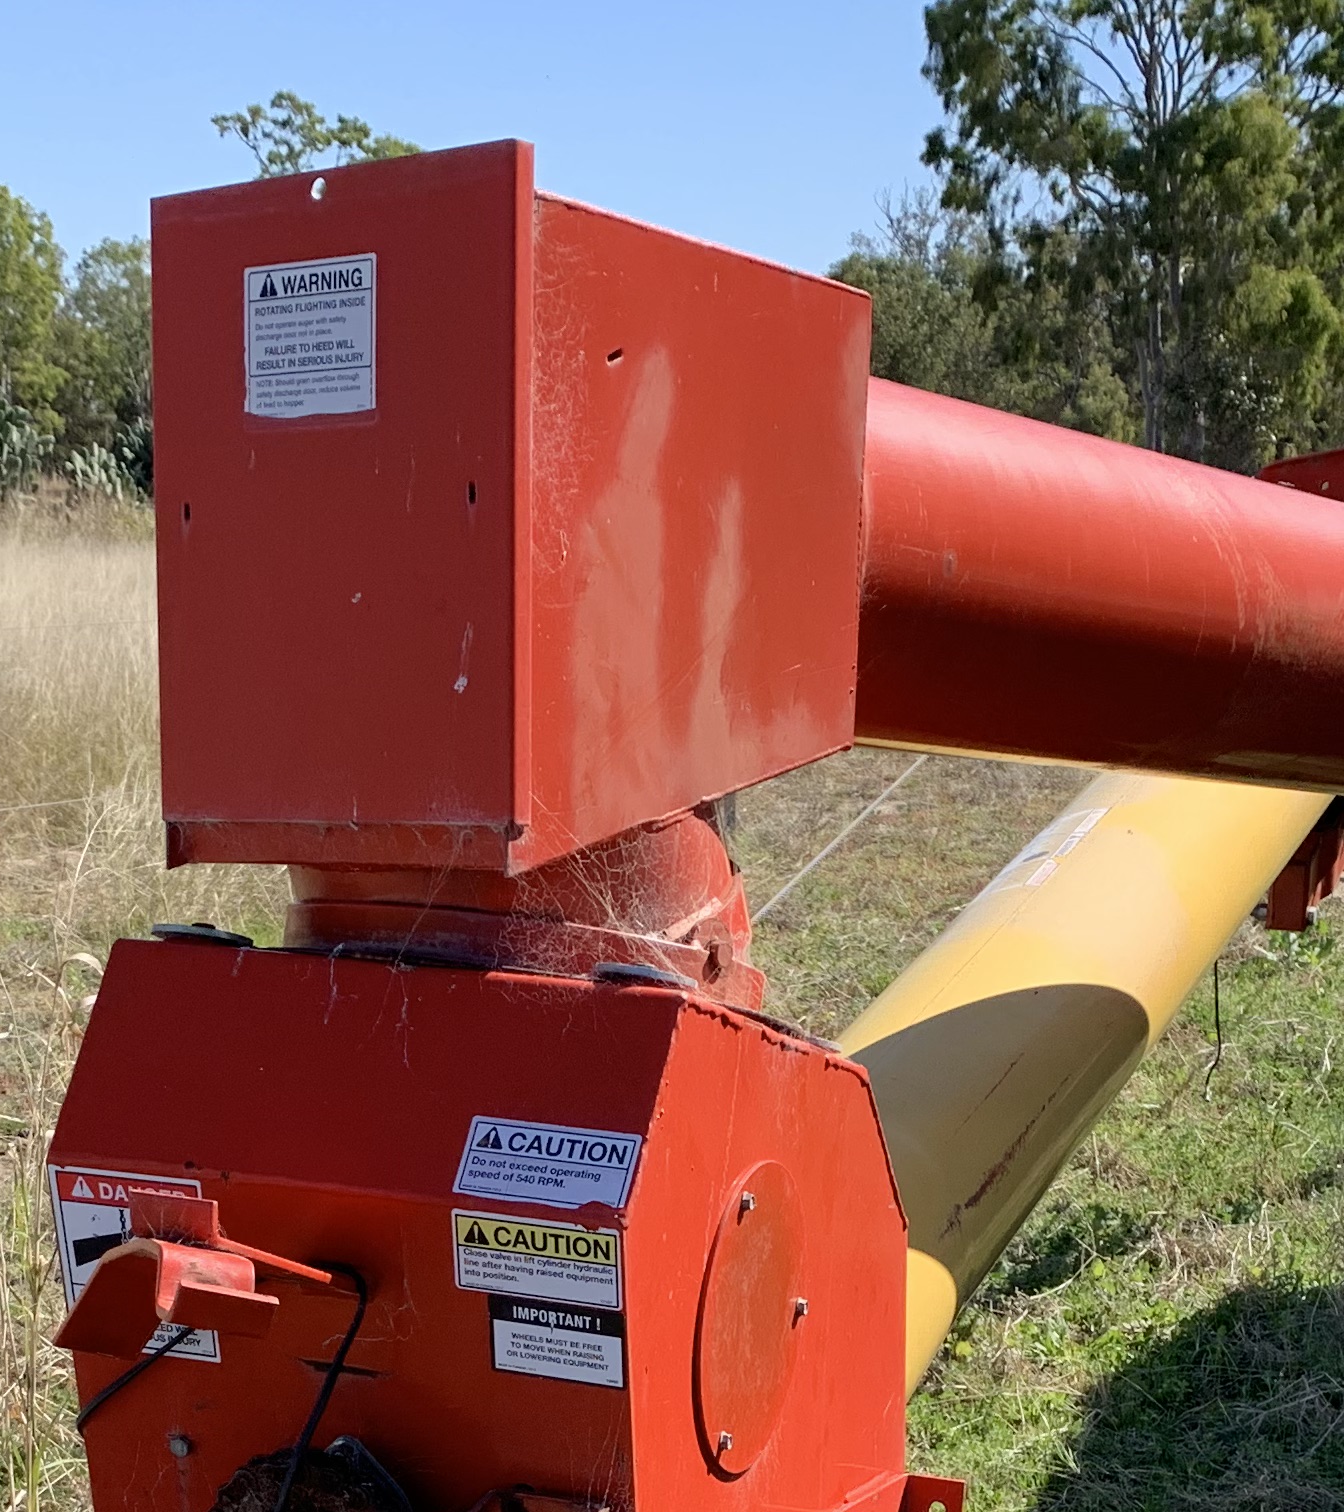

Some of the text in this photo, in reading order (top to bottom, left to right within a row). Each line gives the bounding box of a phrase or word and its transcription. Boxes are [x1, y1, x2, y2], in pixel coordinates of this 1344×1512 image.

[282, 268, 363, 294] WARNING
[255, 296, 366, 316] ROTATING FLIGHTING INSIDE
[265, 339, 355, 355] FAILURE TO HEED WILL
[257, 352, 364, 370] RESULT IN SERIOUS INJURY
[508, 1132, 628, 1164] CAUTION
[472, 1156, 601, 1181] Do not exceed operating
[468, 1170, 565, 1188] speed of 540 RPM.
[494, 1227, 610, 1260] CAUTION
[464, 1248, 488, 1258] Close
[490, 1252, 512, 1262] valve
[524, 1256, 534, 1264] lift
[537, 1258, 571, 1269] cylinder
[574, 1262, 613, 1274] hydraulic
[464, 1259, 613, 1285] line after having raised equipment
[464, 1268, 519, 1282] into position.
[513, 1306, 591, 1330] IMPORTANT
[511, 1341, 604, 1361] TO MOVE WHEN RAISING
[512, 1332, 602, 1352] WHEELS MUST BE FREE
[520, 1352, 561, 1363] LOWERING
[563, 1357, 609, 1371] EQUIPMENT
